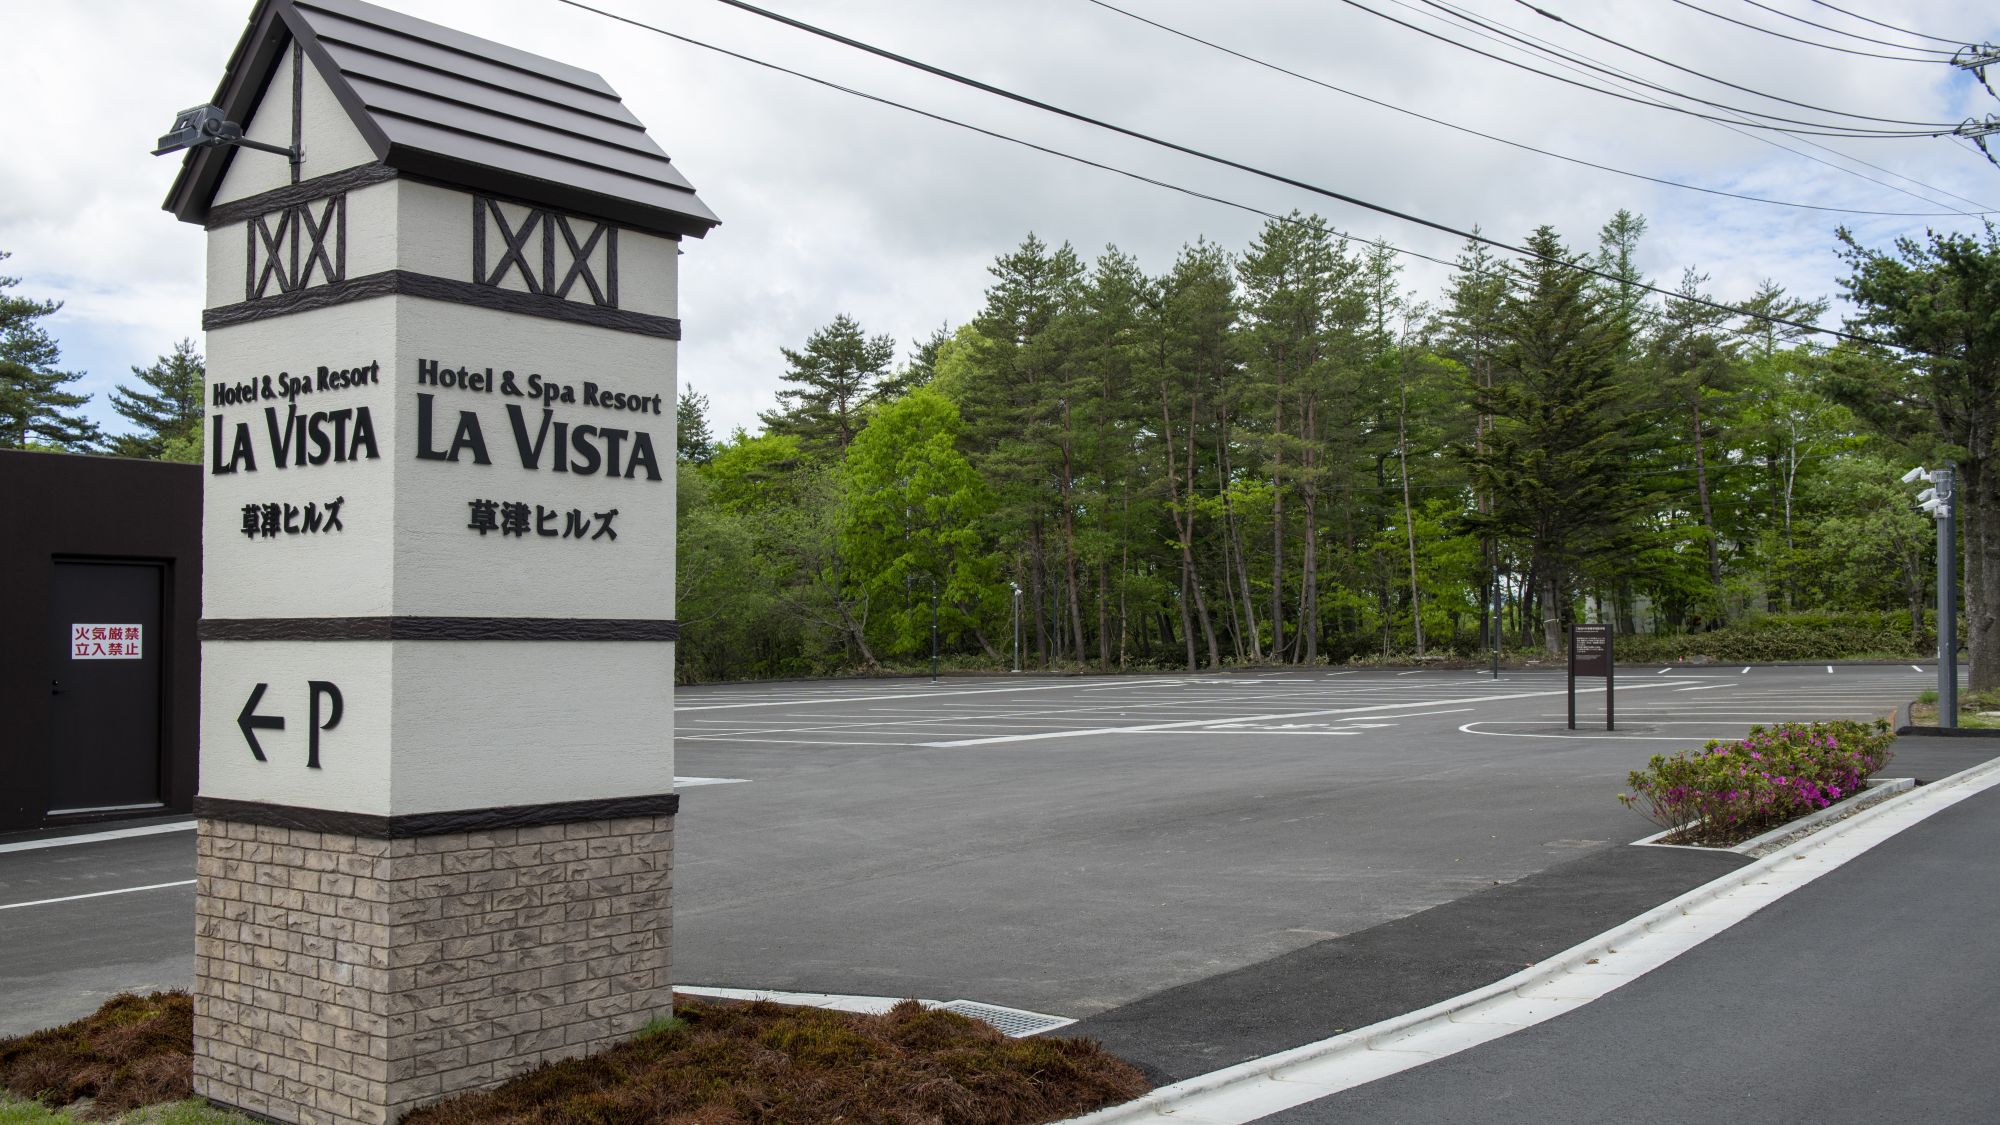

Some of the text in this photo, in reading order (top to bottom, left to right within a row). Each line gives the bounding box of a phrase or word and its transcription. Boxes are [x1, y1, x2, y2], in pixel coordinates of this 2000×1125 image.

[212, 360, 379, 407] Hotel & Spa Resort
[418, 359, 661, 414] Hotel & Spa Resort
[212, 404, 380, 475] LA VISTA
[417, 393, 662, 481] LA VISTA
[241, 496, 344, 538] 草津ヒルズ
[469, 499, 619, 540] 草津ヒルズ
[75, 627, 139, 640] 火気厳禁
[75, 643, 139, 656] 立入禁止
[306, 681, 344, 769] P
